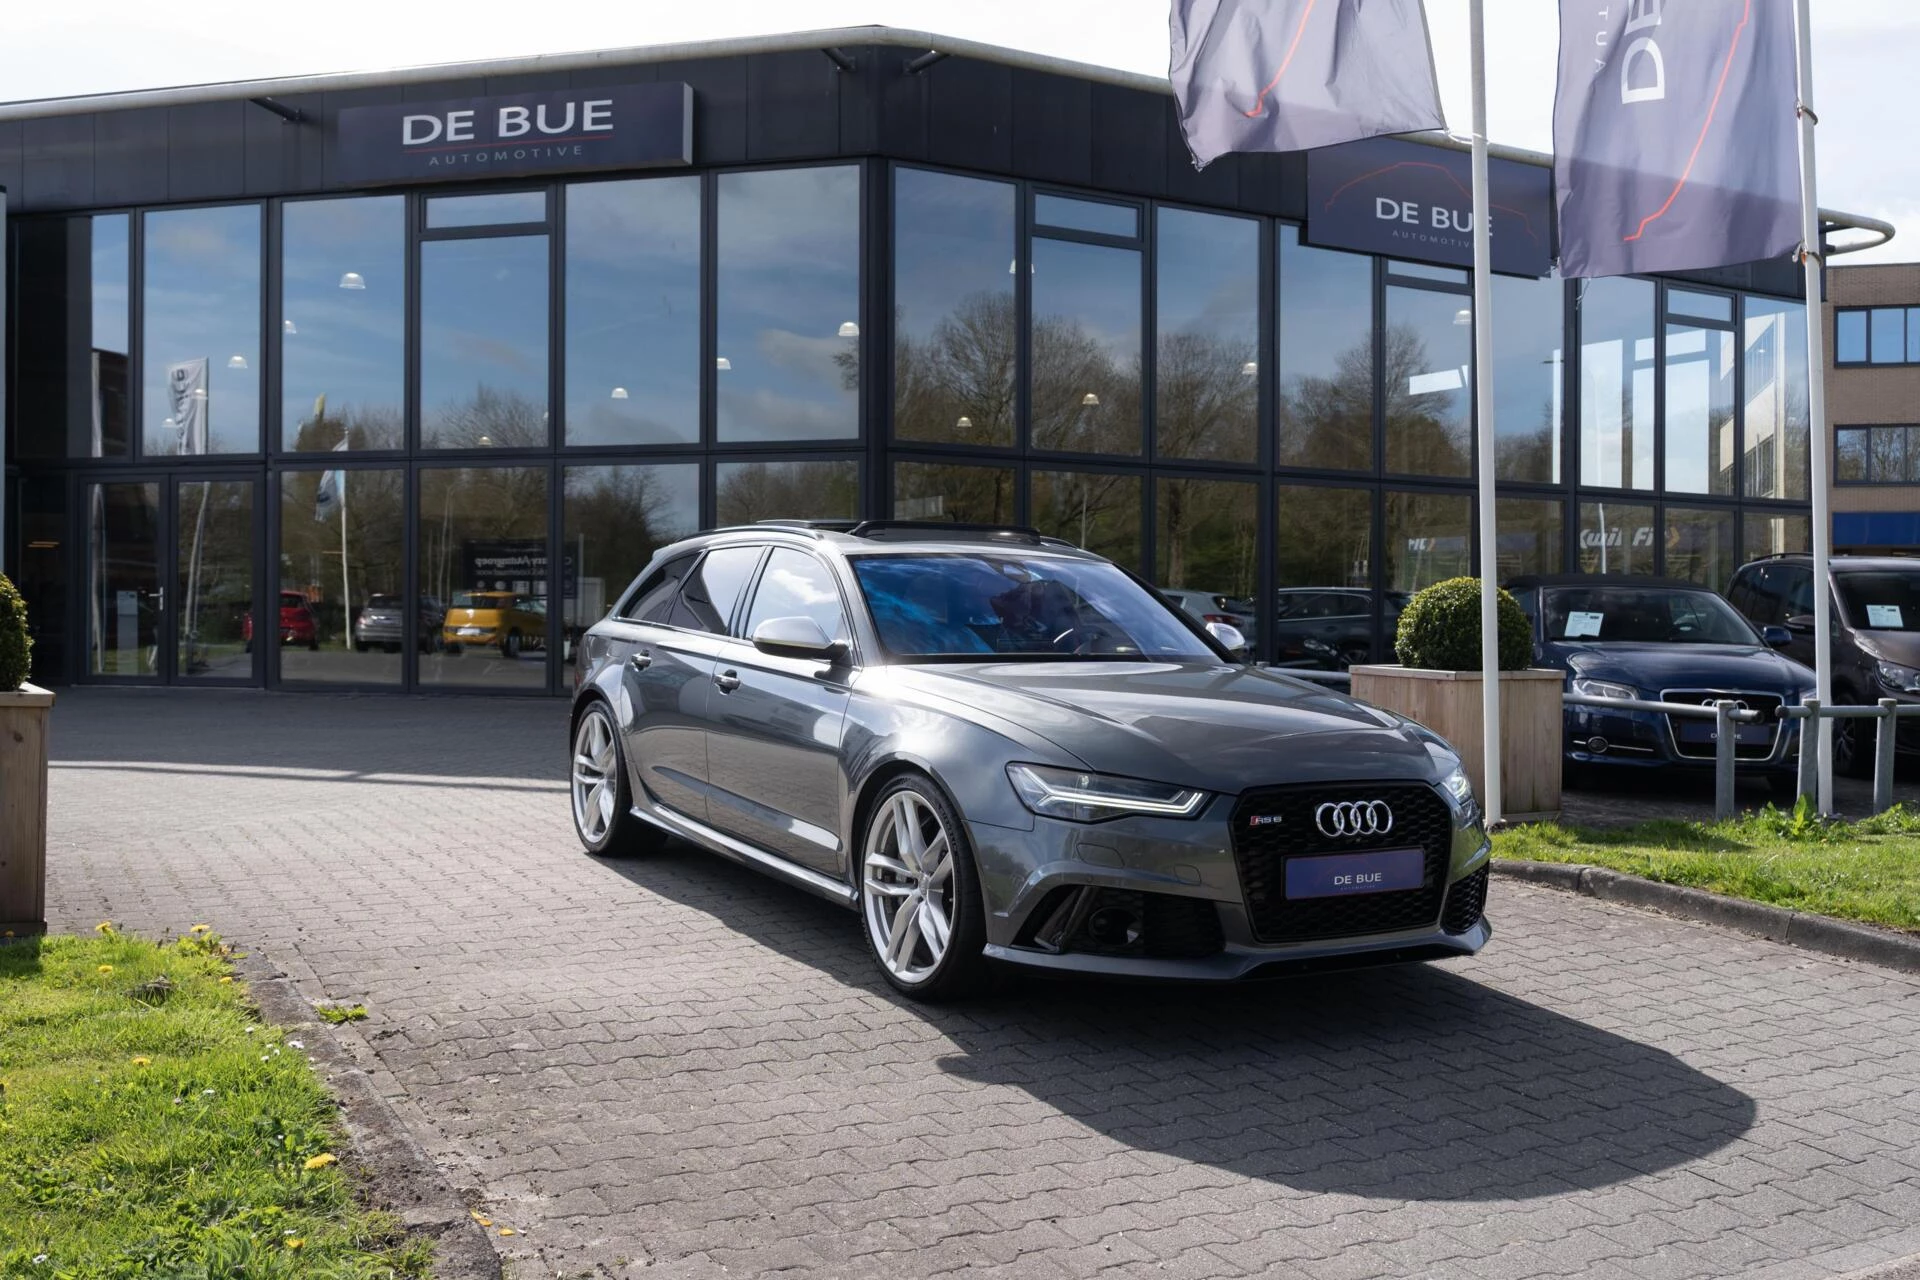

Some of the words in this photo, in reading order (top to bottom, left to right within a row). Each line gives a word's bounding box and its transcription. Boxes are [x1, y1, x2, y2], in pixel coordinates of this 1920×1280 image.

[402, 110, 475, 146] DE
[498, 100, 613, 138] BUE
[429, 145, 582, 166] AUTOMOTIVE
[1376, 197, 1419, 225] DE
[1392, 231, 1475, 248] AUTOMOTIV
[1334, 874, 1352, 885] DE
[1356, 872, 1382, 883] BUE
